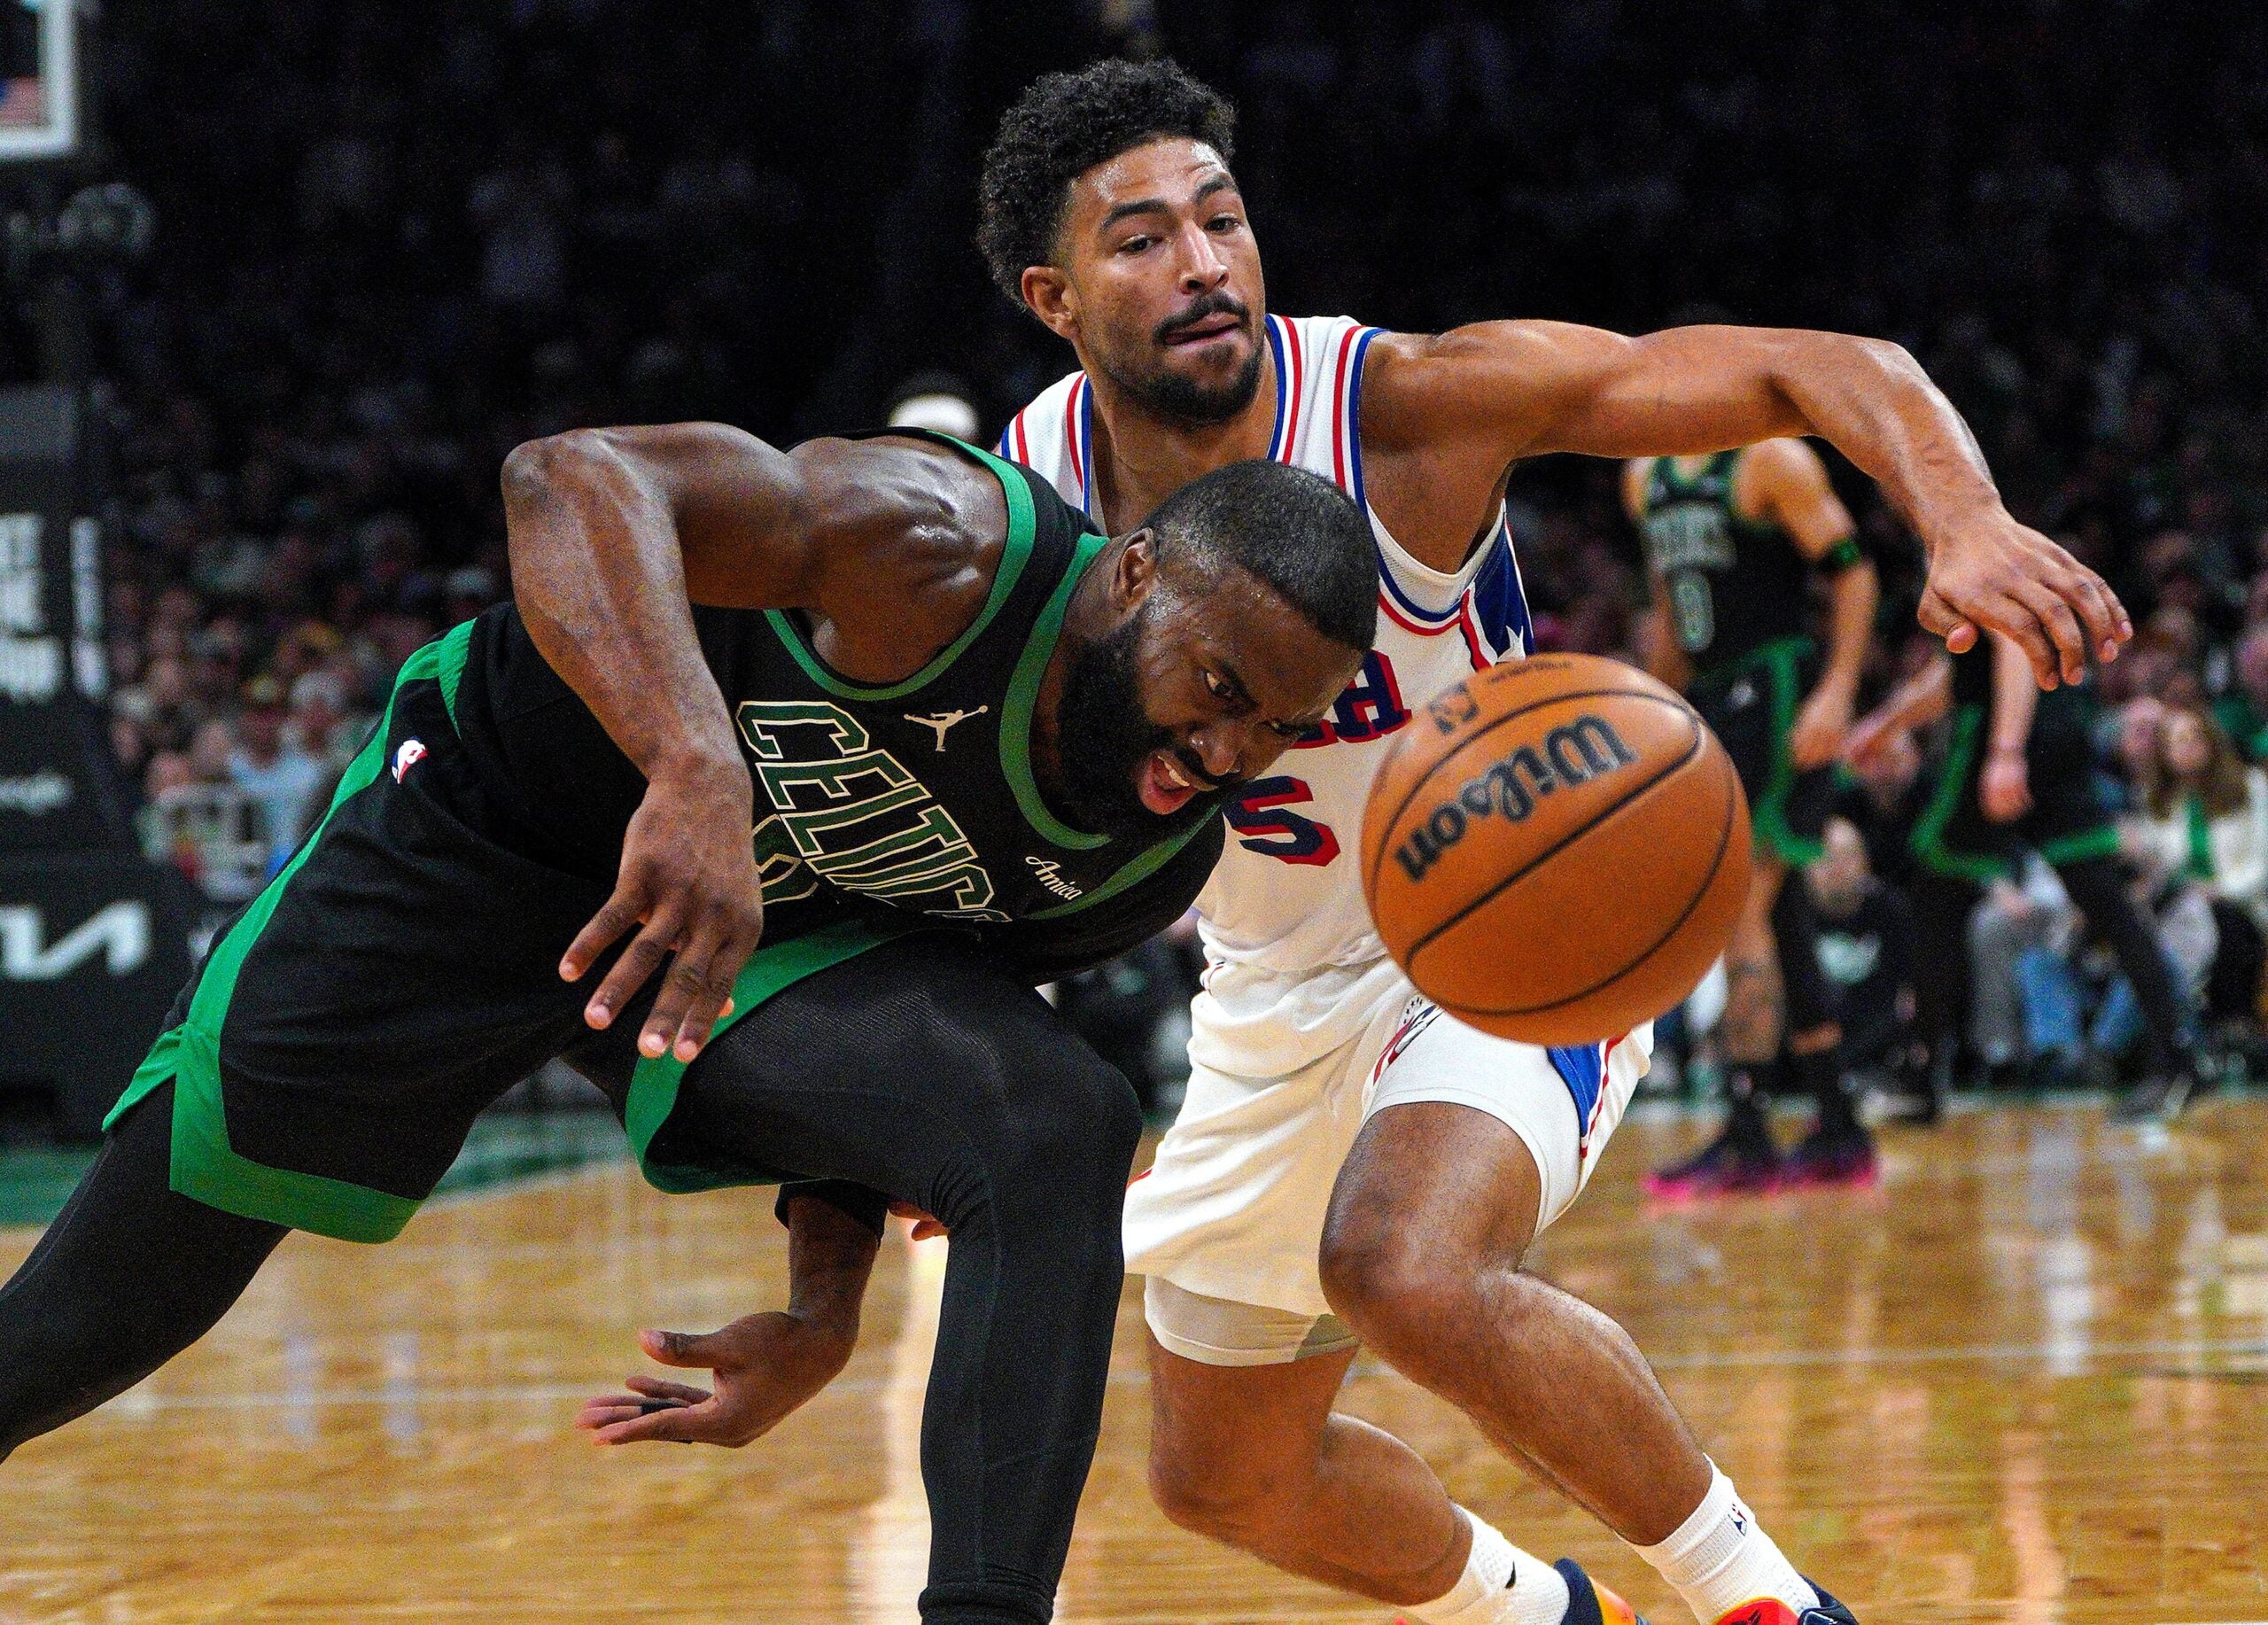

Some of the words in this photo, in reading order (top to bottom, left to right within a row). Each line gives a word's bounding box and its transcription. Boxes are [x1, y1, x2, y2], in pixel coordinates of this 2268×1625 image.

[1221, 775, 1340, 867] 5
[1394, 714, 1640, 883] Wilson
[1025, 856, 1084, 900] Amica
